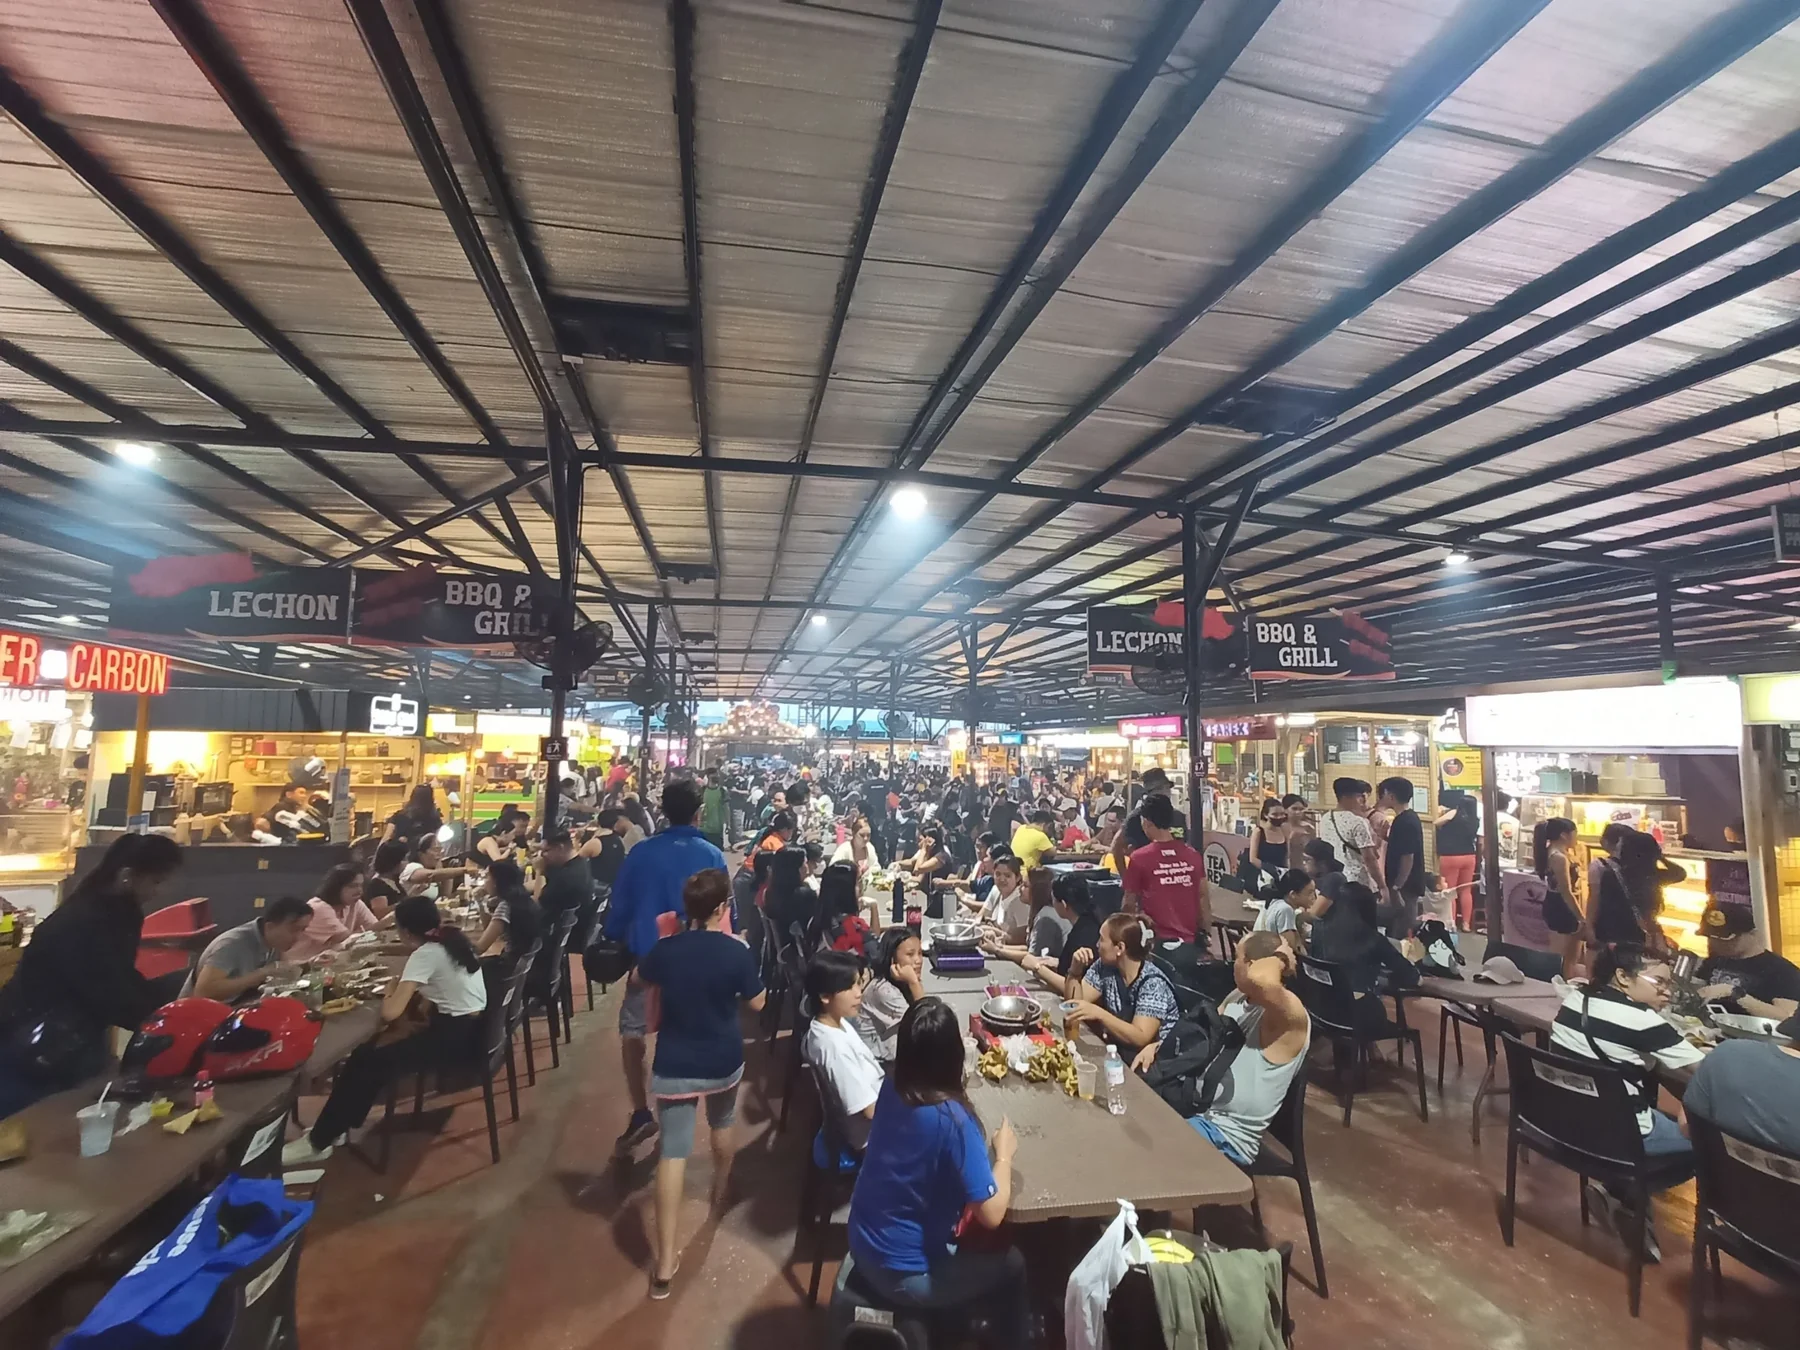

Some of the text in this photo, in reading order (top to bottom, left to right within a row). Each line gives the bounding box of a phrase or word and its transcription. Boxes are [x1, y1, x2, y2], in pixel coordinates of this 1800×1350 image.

[208, 590, 339, 621] LECHON
[444, 581, 532, 609] BBQ &
[1096, 630, 1183, 653] LECHON
[1256, 622, 1317, 645] BBQ &
[1279, 647, 1338, 667] GRILL
[69, 644, 168, 695] CARBON
[1207, 855, 1226, 872] TEA
